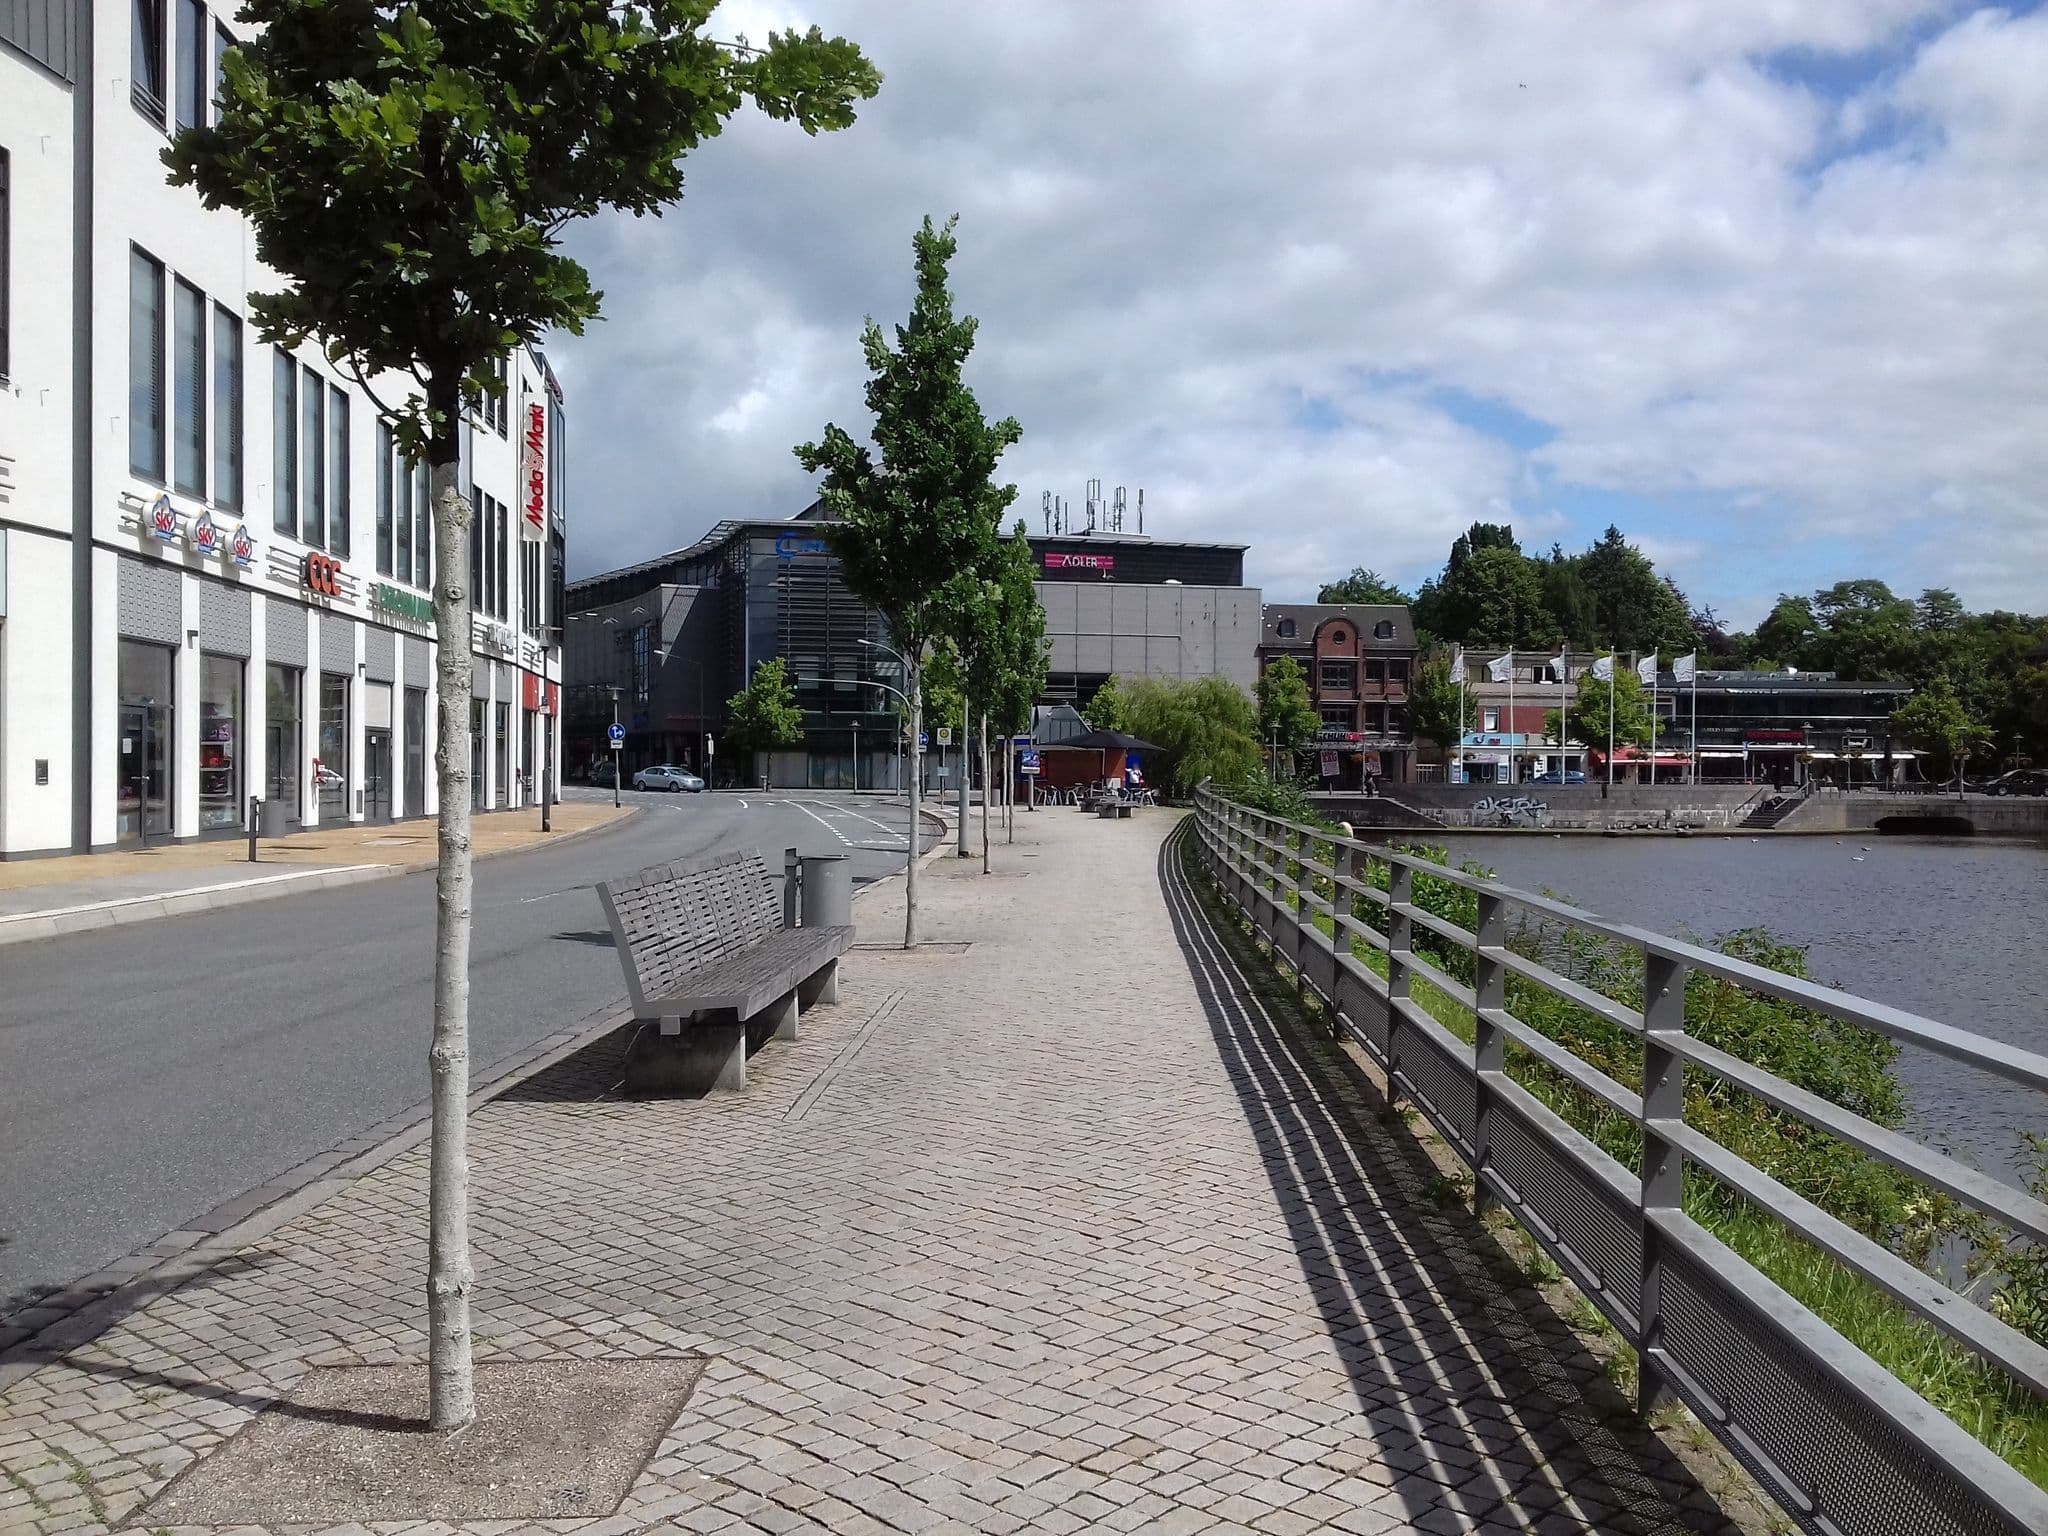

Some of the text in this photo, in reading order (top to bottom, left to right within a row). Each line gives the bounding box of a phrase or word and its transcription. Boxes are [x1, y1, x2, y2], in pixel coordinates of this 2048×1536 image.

[526, 402, 544, 532] Media Markt
[1062, 555, 1098, 567] ADLER
